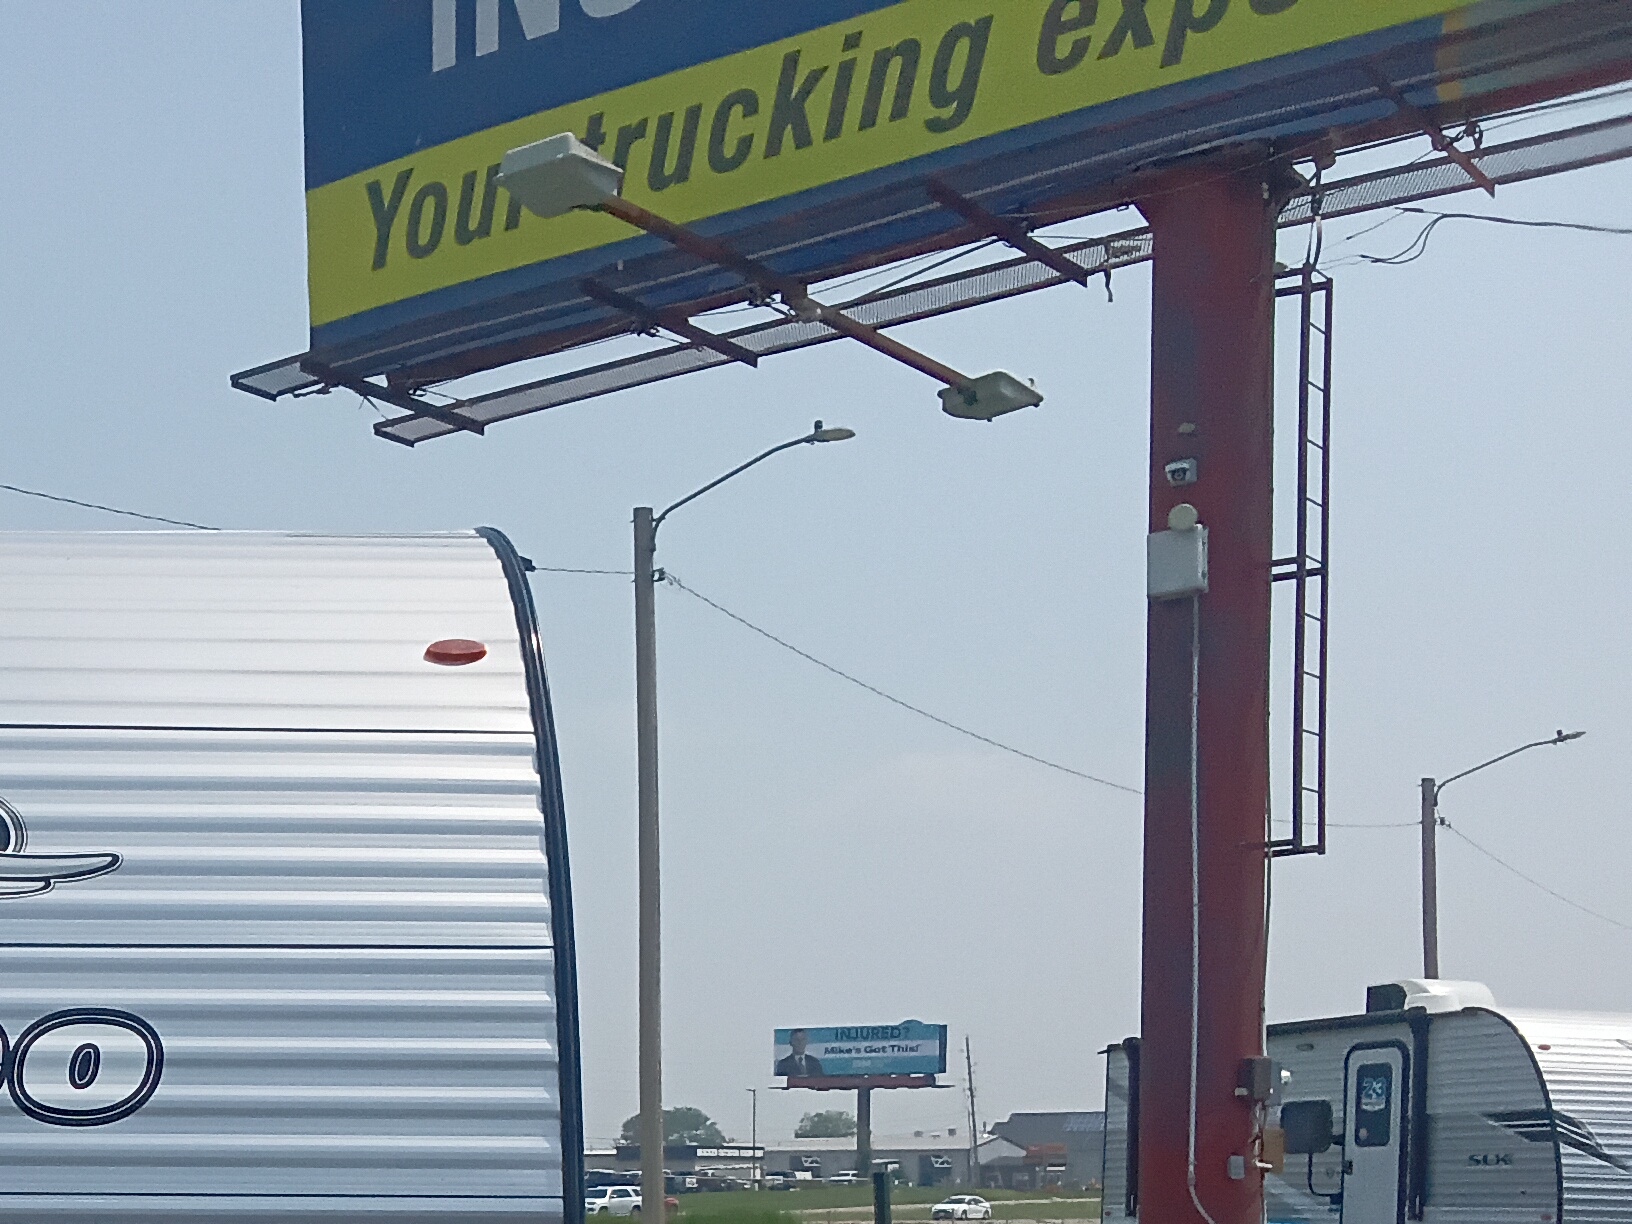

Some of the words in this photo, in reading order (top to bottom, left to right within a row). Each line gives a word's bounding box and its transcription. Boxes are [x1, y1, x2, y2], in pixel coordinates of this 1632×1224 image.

[1035, 0, 1301, 75] exp
[834, 1026, 910, 1041] INJURED?
[824, 1046, 861, 1055] Mike's
[864, 1045, 888, 1054] Got
